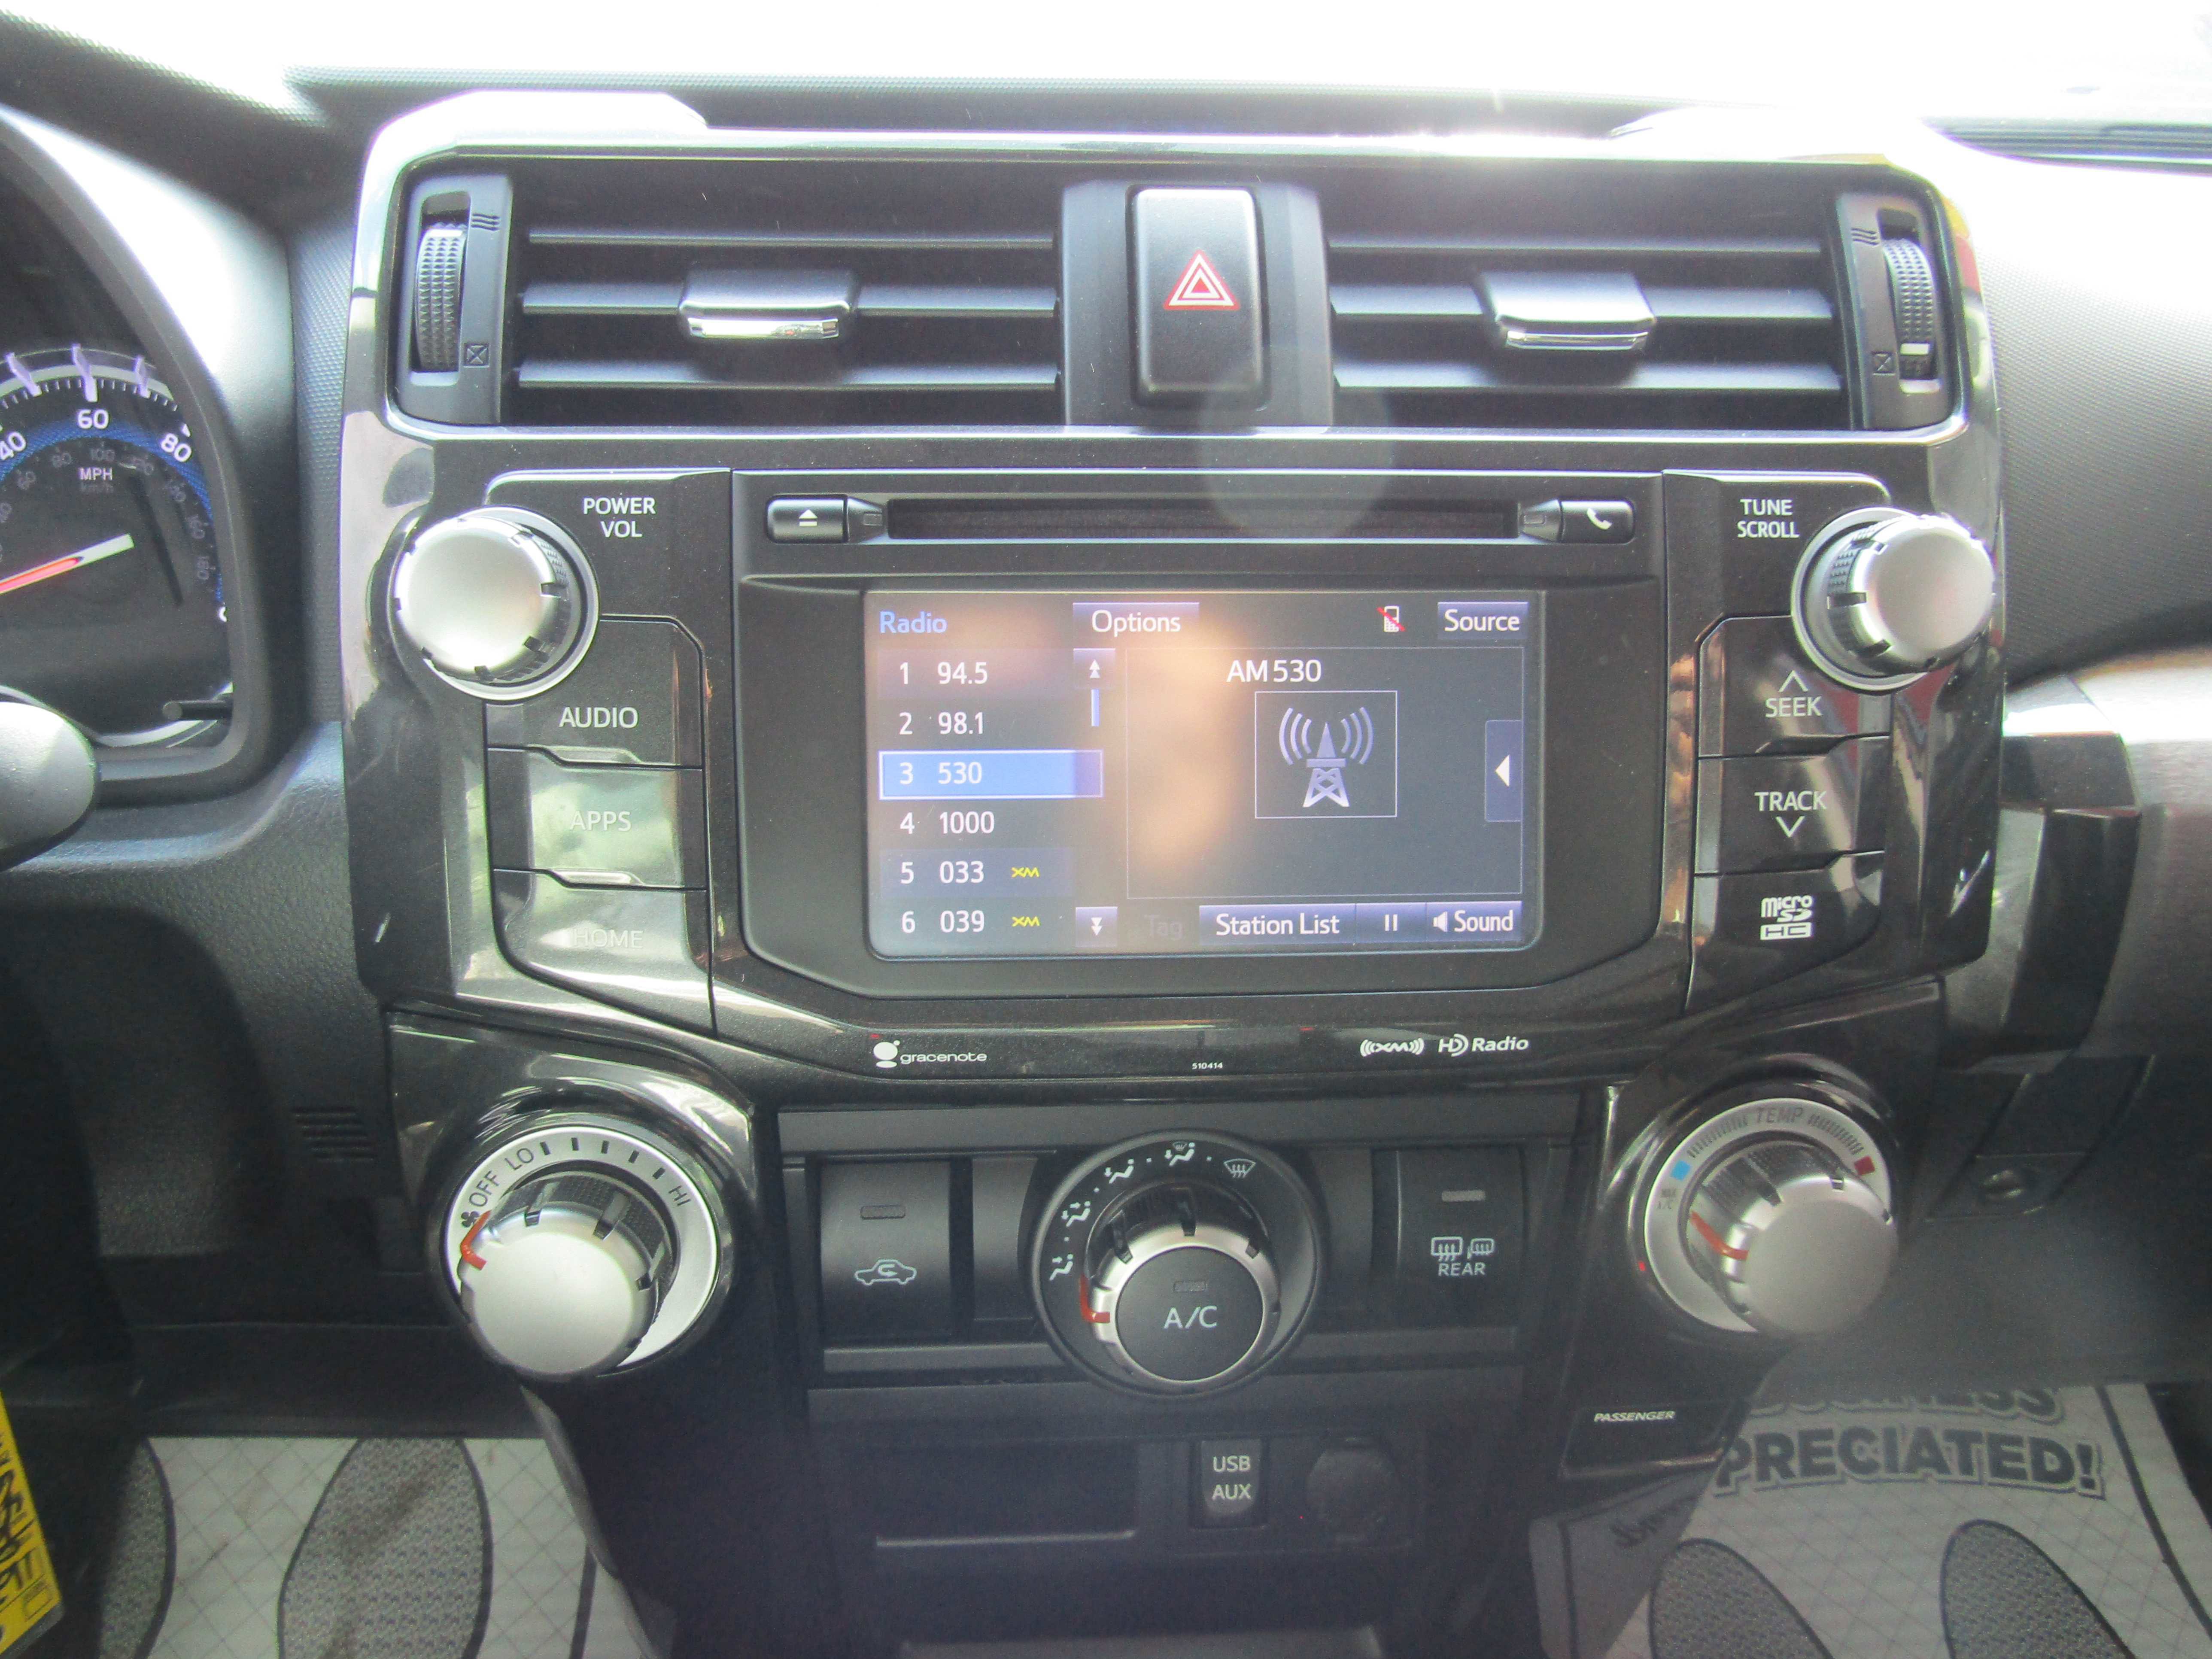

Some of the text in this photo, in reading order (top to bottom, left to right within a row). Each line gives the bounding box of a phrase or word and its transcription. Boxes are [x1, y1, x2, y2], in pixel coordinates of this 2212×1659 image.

[77, 410, 109, 429] 60
[0, 431, 26, 460] 40
[161, 432, 192, 462] 80
[79, 467, 113, 481] MPH
[583, 497, 656, 515] POWER
[1740, 498, 1793, 516] TUNE
[600, 520, 643, 538] VOL
[1737, 520, 1800, 539] SCROLL
[879, 610, 948, 634] Radio
[1091, 609, 1182, 637] Options
[1444, 609, 1520, 632] Source
[899, 661, 988, 685] 1 94.5
[1226, 659, 1322, 683] AM 530
[559, 706, 639, 729] AUDIO
[1765, 696, 1823, 718] SEEK
[899, 711, 984, 735] 2 98.1
[899, 761, 983, 785] 3 530
[1754, 790, 1827, 812] TRACK
[570, 810, 632, 832] APPS
[899, 811, 996, 835] 4 1000
[900, 862, 915, 884] 5
[939, 860, 985, 884] 033
[1761, 895, 1813, 918] micro
[901, 911, 916, 933] 6
[940, 910, 985, 933] 039
[1215, 912, 1340, 936] Station List
[1454, 910, 1514, 933] Sound
[573, 929, 643, 948] HOME
[1438, 1034, 1529, 1057] HD Radio
[899, 1051, 987, 1066] gracenote
[1191, 1061, 1223, 1070] 510414
[1756, 1106, 1803, 1124] TEMP
[504, 1147, 535, 1171] LO
[468, 1170, 501, 1208] OFF
[668, 1185, 691, 1207] HI
[1438, 1261, 1486, 1277] REAR
[1163, 1304, 1218, 1330] A/C
[1593, 1410, 1676, 1422] PASSENGER
[1212, 1455, 1251, 1473] USB
[1212, 1483, 1252, 1501] AUX
